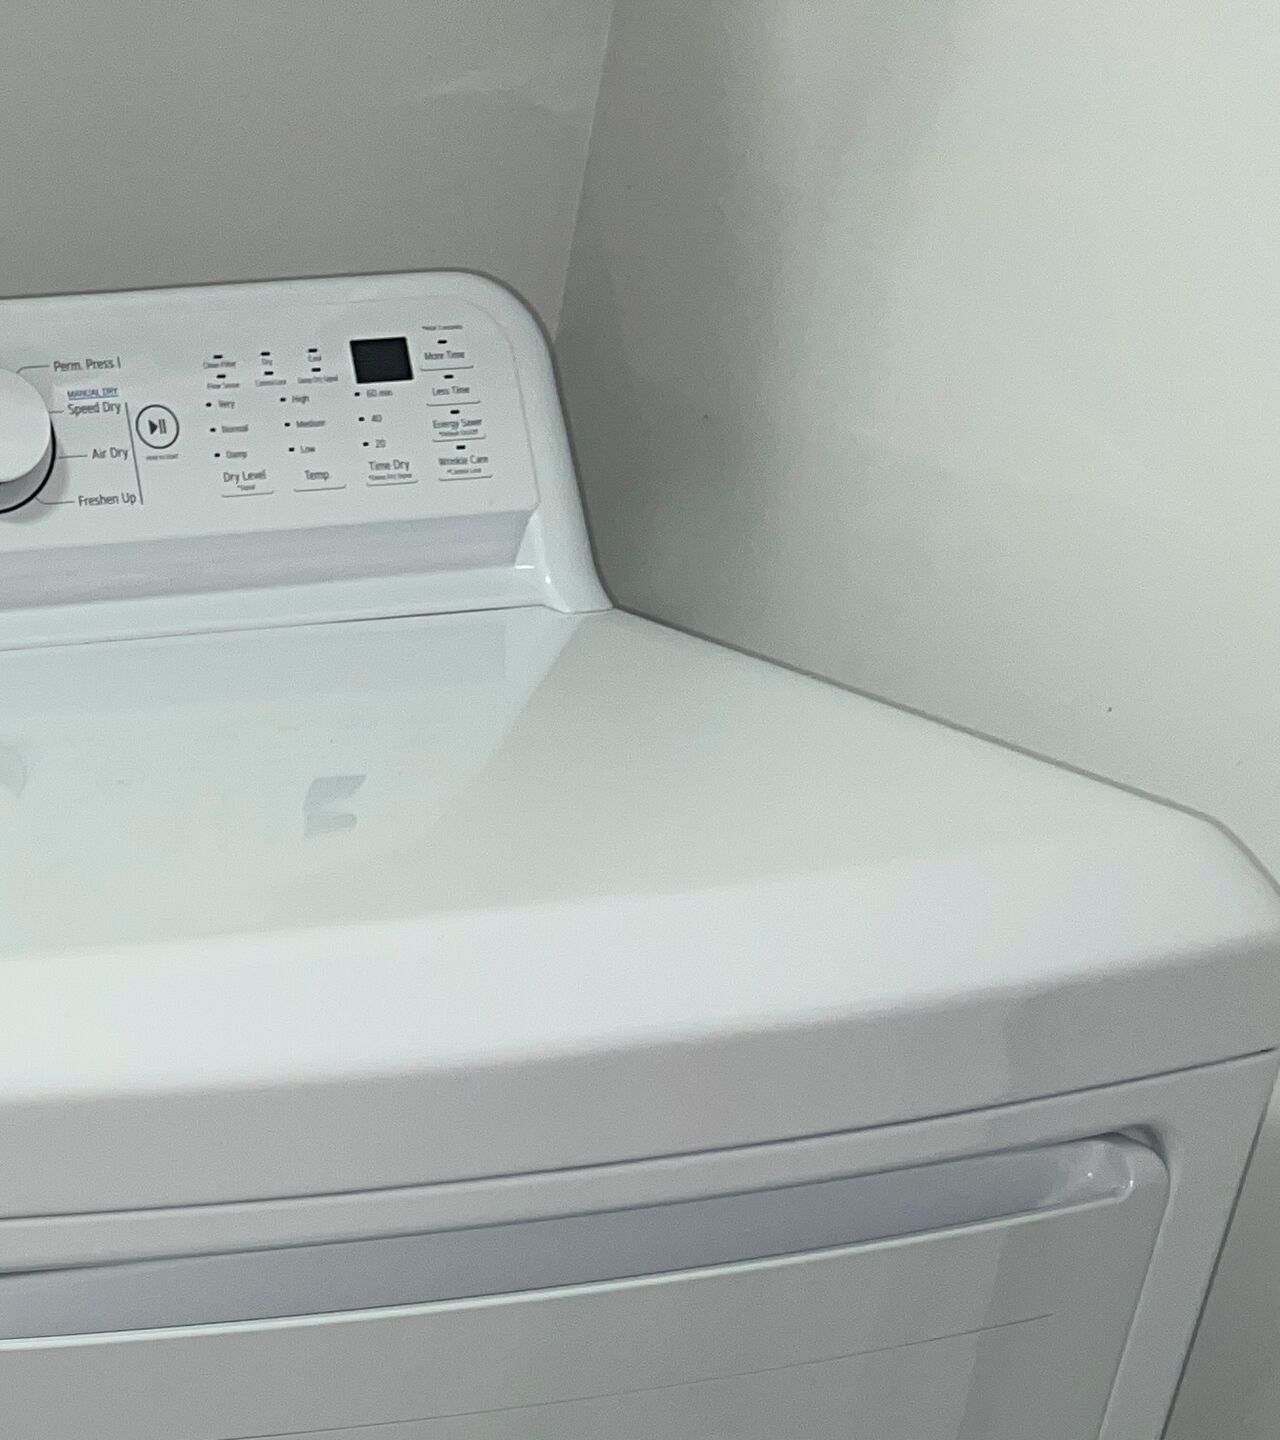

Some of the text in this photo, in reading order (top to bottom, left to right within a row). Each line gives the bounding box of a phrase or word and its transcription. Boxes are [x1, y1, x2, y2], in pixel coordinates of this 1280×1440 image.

[424, 350, 465, 360] More Time
[86, 359, 114, 370] Press
[102, 387, 118, 398] DRY
[366, 389, 377, 397] 60
[432, 386, 470, 396] Less Time
[68, 401, 121, 416] Speed Dry
[371, 414, 383, 423] 40
[92, 447, 128, 461] Air Dry
[368, 459, 410, 472] Time Dry
[223, 469, 266, 484] Dry Level
[78, 493, 137, 507] Freshen Up
